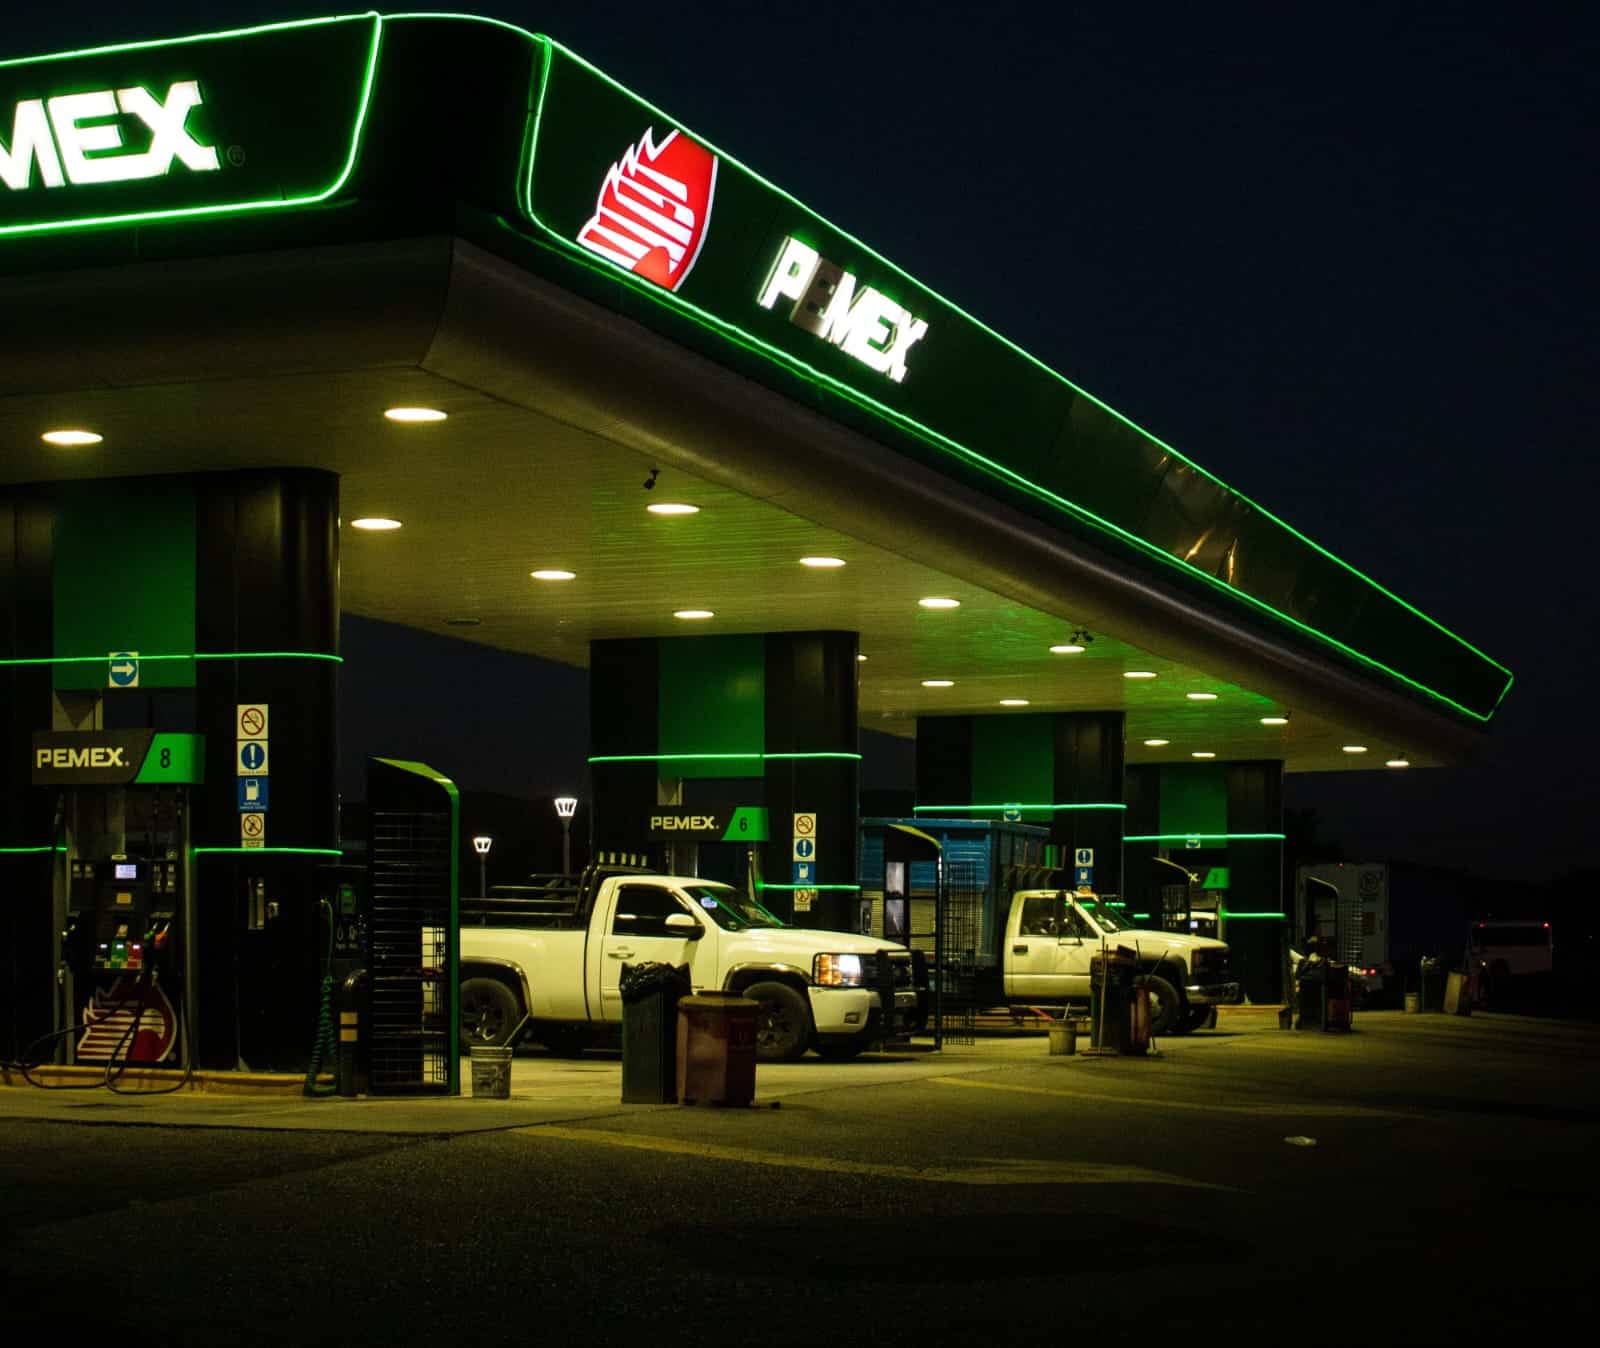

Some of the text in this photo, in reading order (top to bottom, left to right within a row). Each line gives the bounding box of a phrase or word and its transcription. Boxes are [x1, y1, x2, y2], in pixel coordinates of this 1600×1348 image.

[756, 235, 928, 384] PEMEX
[160, 747, 171, 769] 8
[739, 816, 749, 832] 6
